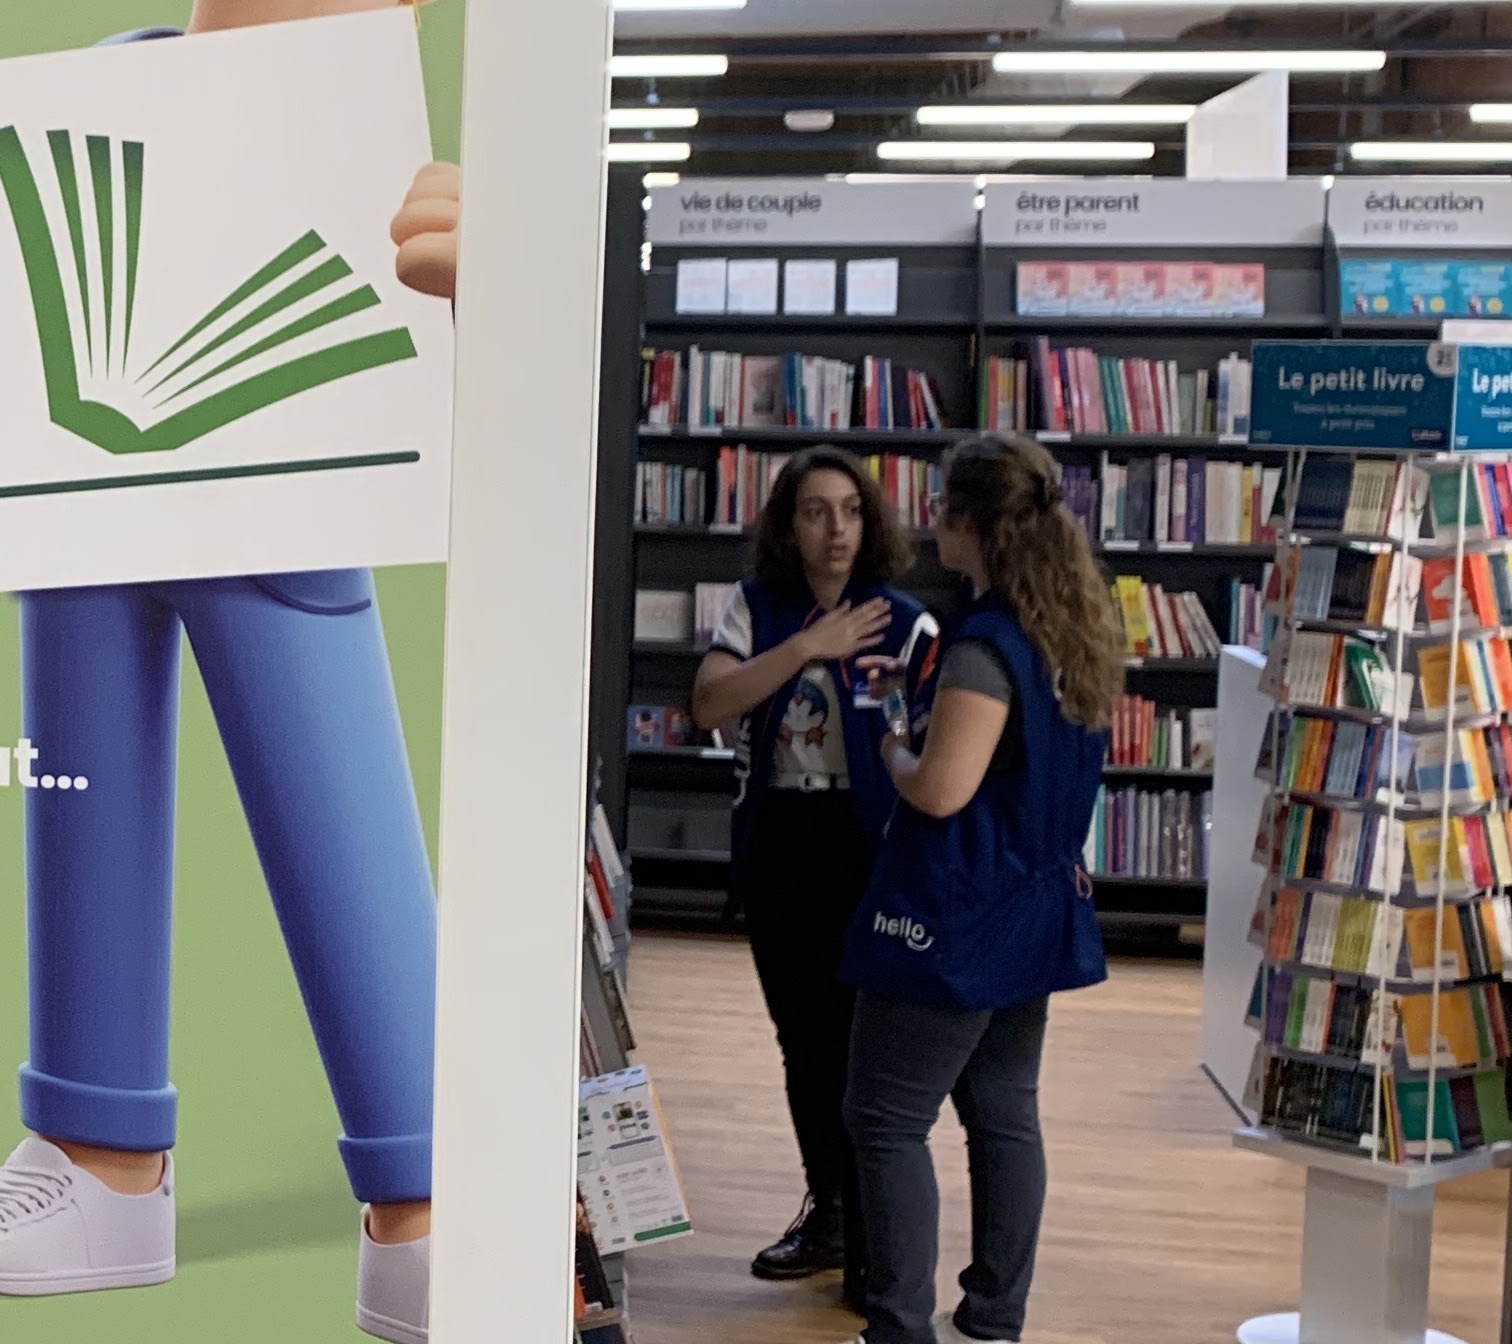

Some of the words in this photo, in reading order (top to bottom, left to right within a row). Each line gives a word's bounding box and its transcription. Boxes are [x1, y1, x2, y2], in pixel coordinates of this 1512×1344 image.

[679, 192, 712, 212] vie
[714, 192, 744, 212] de
[747, 192, 822, 217] couple
[1016, 191, 1060, 212] être
[1063, 193, 1140, 217] parent
[1365, 190, 1485, 213] éducation
[1278, 366, 1304, 391] Le
[1310, 366, 1366, 396] petit
[1373, 366, 1426, 392] livre
[1472, 367, 1489, 393] Le
[874, 911, 928, 943] hello
